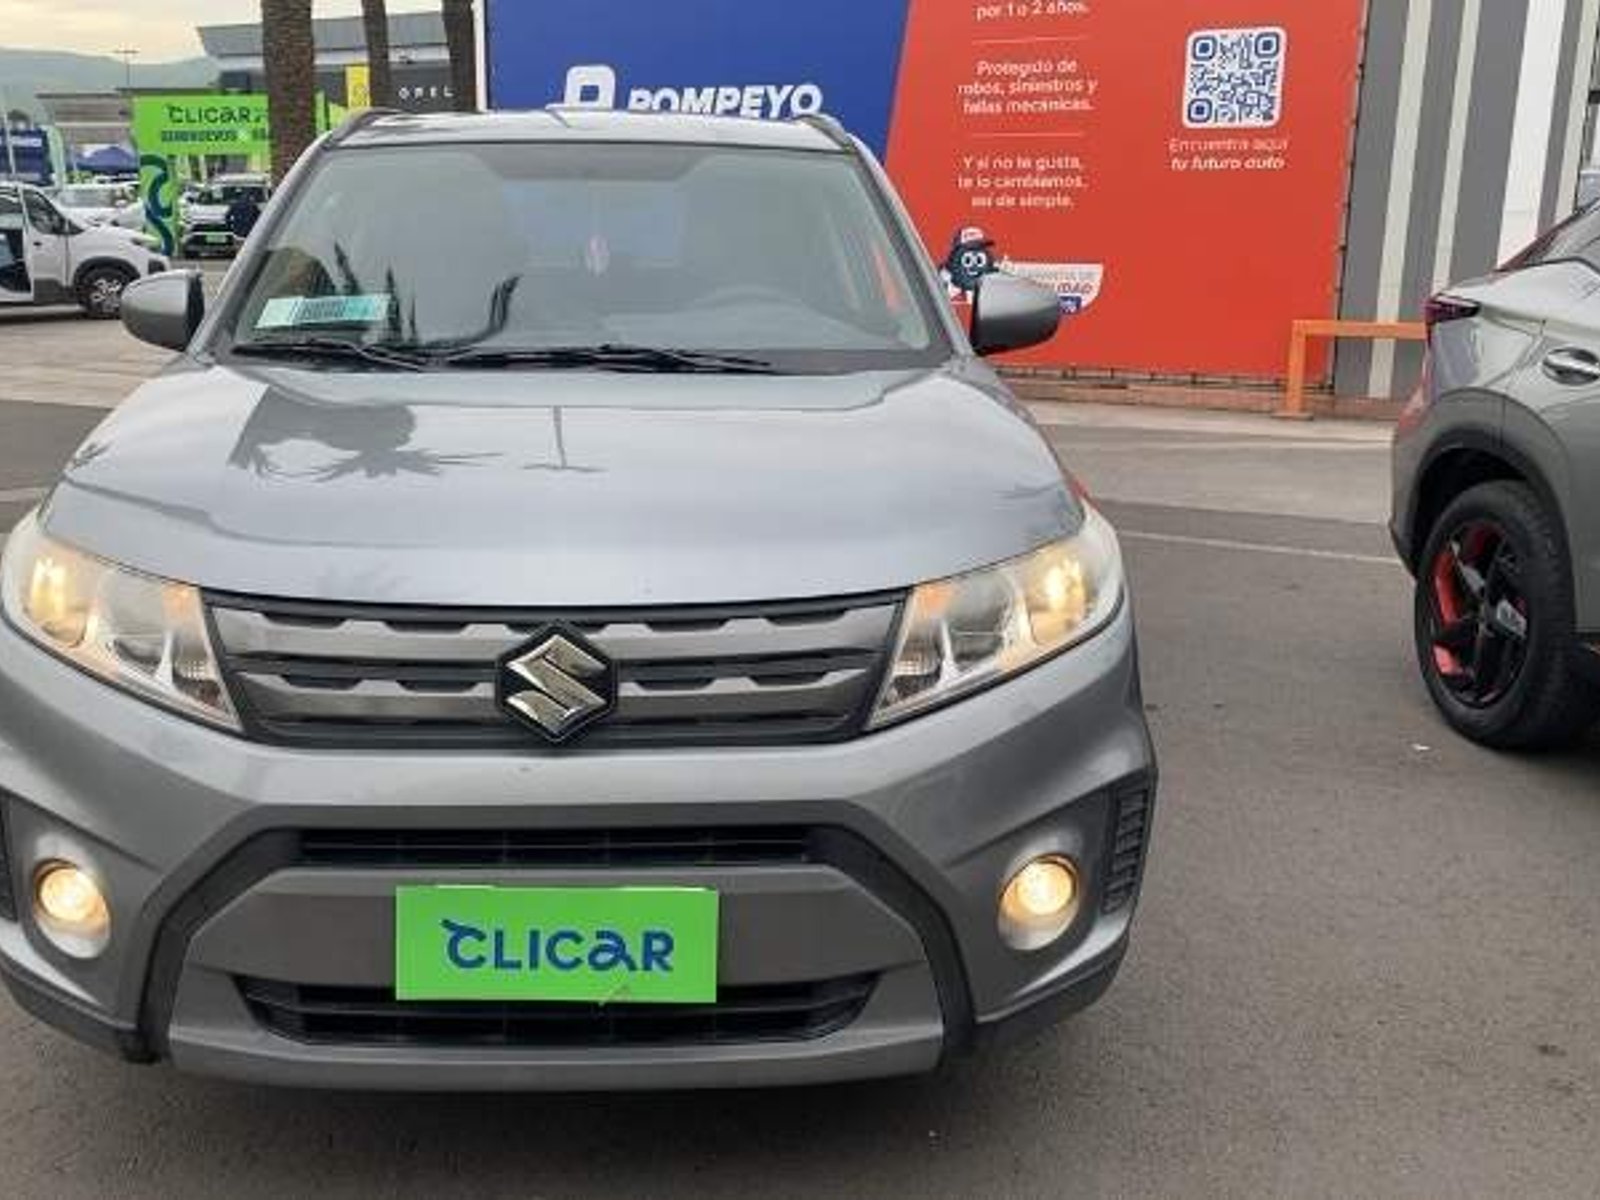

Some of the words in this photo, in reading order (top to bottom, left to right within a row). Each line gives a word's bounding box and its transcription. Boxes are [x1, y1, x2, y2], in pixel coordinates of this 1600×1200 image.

[976, 60, 1054, 77] Protegido
[1057, 59, 1078, 73] de
[1008, 77, 1084, 95] siniestros
[1168, 138, 1249, 152] Encuentra
[993, 157, 1014, 169] no
[1171, 157, 1189, 171] tu
[1191, 156, 1241, 171] futuro
[1243, 156, 1286, 170] auto
